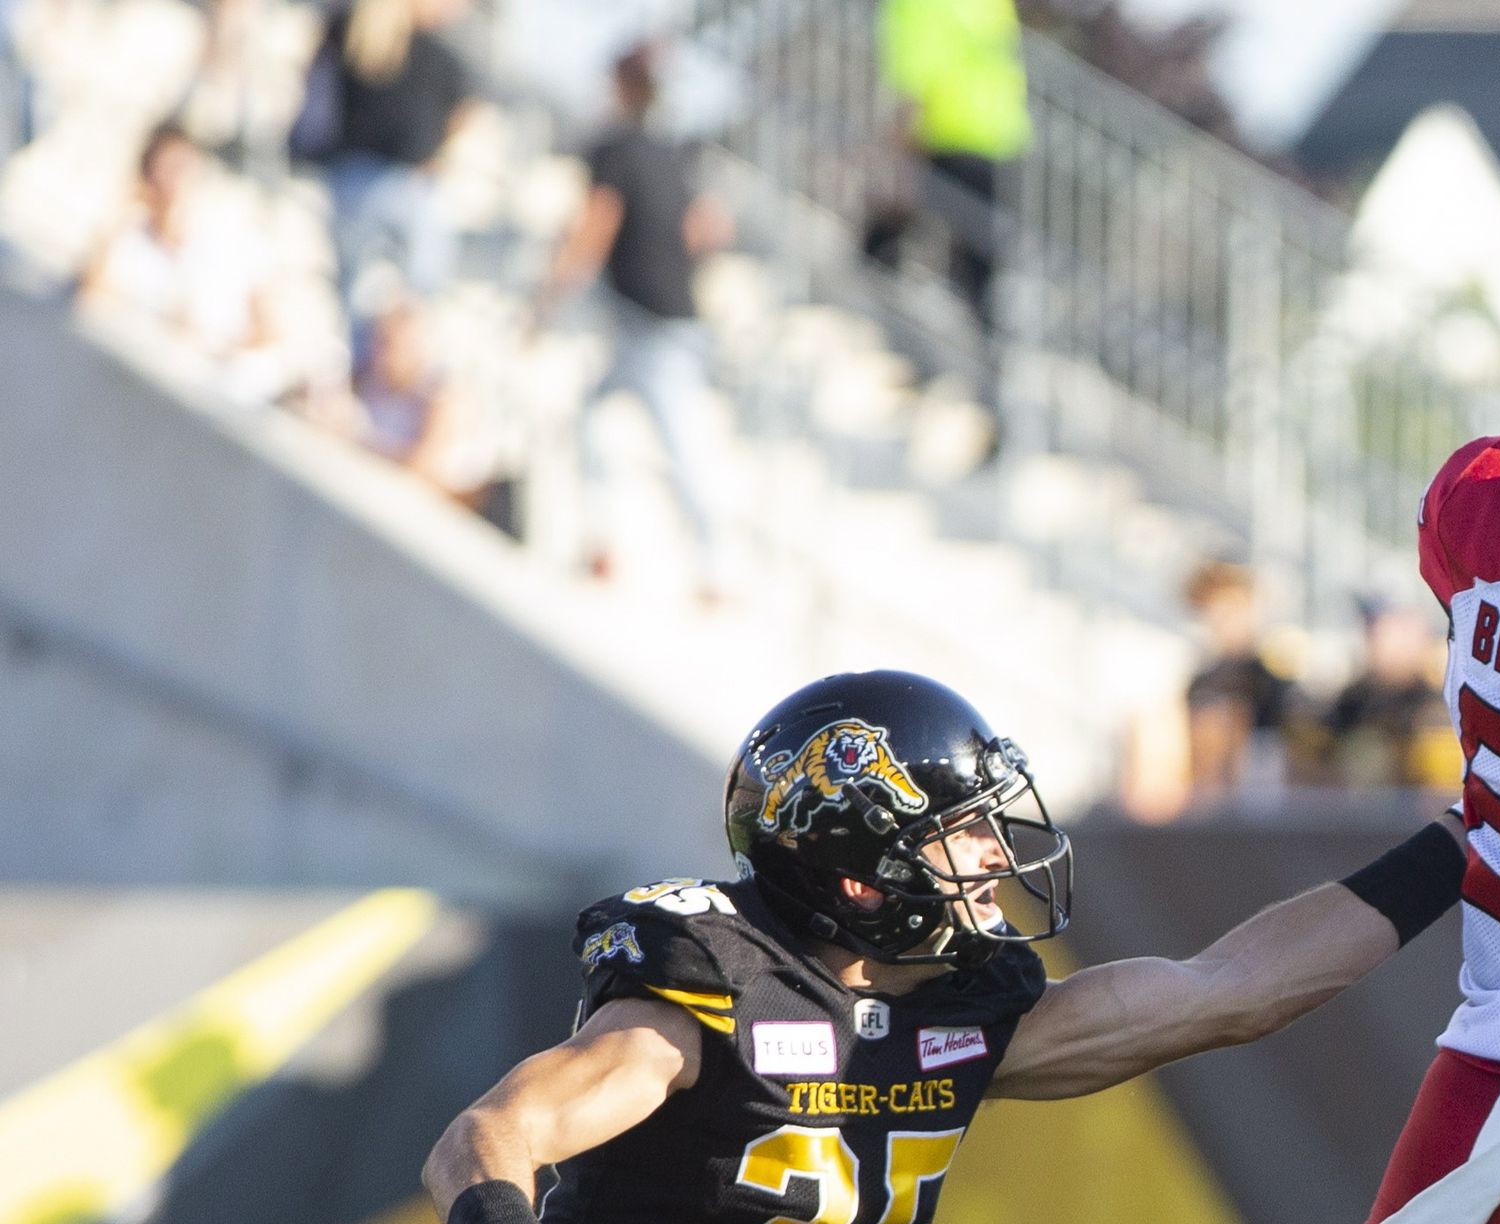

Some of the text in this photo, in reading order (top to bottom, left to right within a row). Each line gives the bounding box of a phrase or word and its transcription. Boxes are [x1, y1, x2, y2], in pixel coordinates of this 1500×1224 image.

[861, 1010, 884, 1030] CFL
[763, 1040, 829, 1056] TELUS
[921, 1037, 943, 1058] Tim
[786, 1078, 955, 1115] TIGER-CATS
